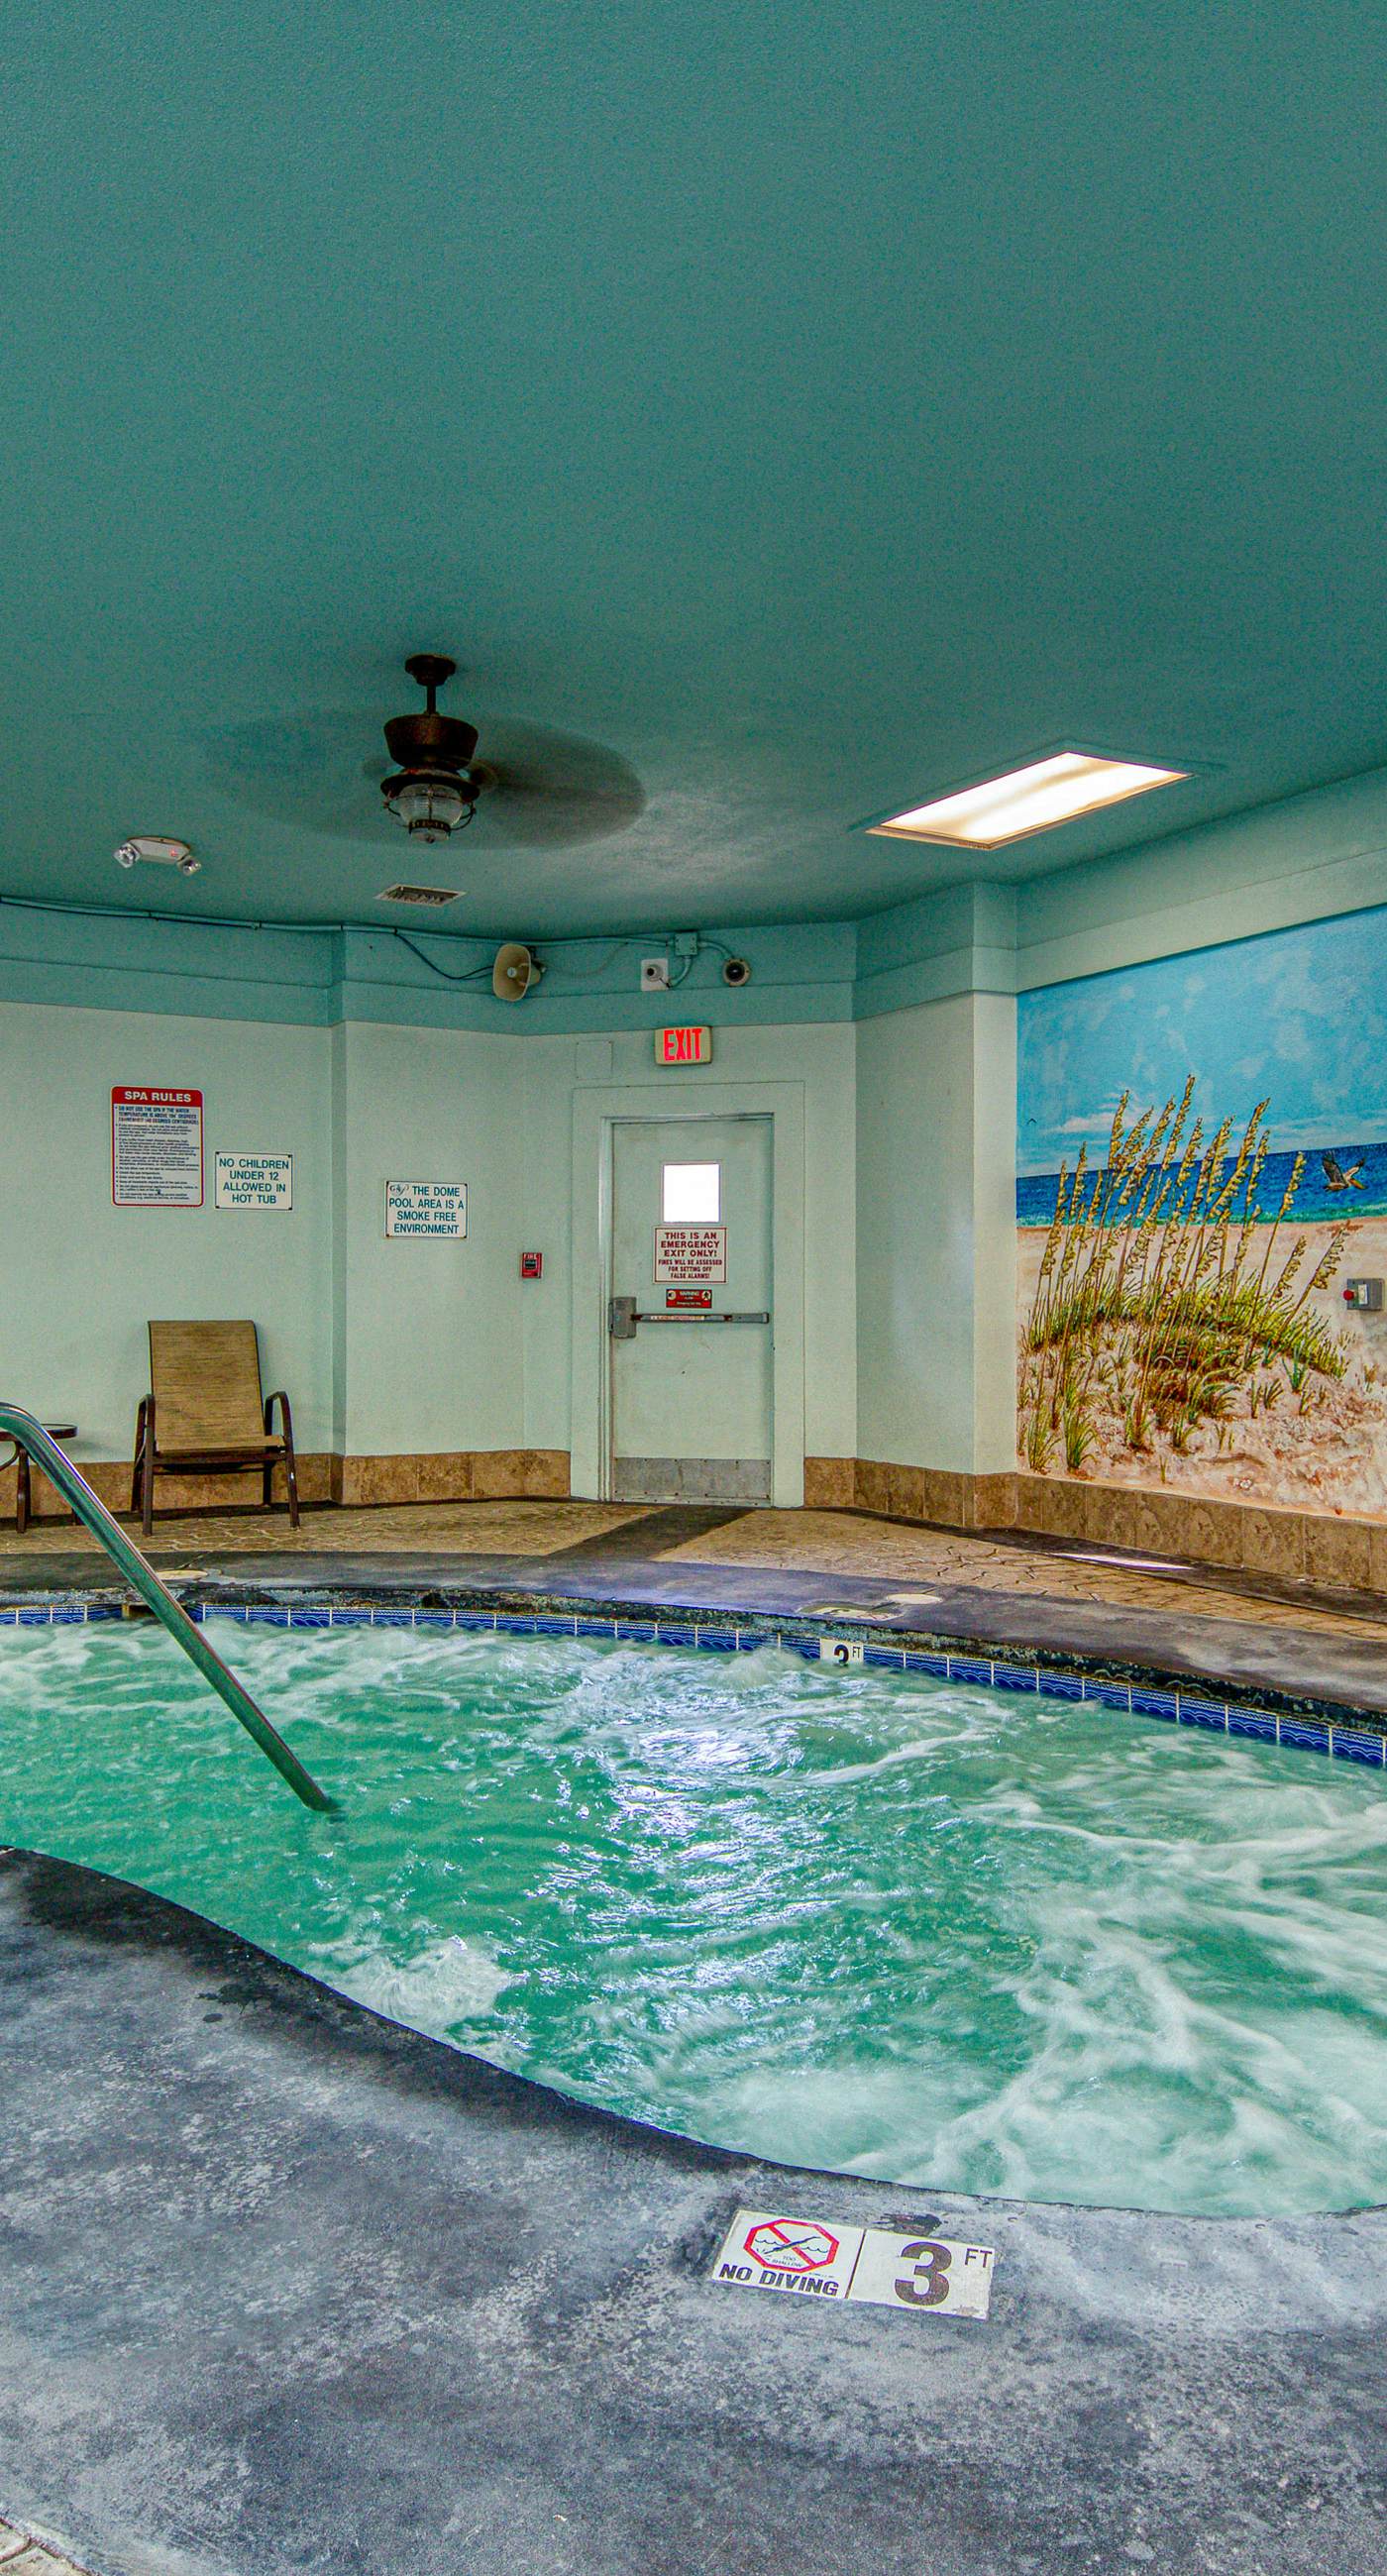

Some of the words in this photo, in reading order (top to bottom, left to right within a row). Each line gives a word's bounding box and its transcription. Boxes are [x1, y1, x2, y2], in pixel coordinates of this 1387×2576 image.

[664, 1028, 703, 1060] EXIT
[124, 1091, 148, 1100] SPA
[151, 1092, 191, 1102] RULES
[219, 1158, 234, 1167] NO
[239, 1159, 289, 1169] CHILDREN
[230, 1171, 264, 1180] UNDER
[269, 1172, 279, 1181] 12
[223, 1182, 272, 1192] ALLOWED
[276, 1184, 286, 1192] IN
[412, 1186, 429, 1195] THE
[434, 1187, 460, 1196] DOME
[232, 1194, 252, 1203] HOT
[257, 1195, 277, 1204] TUB
[389, 1198, 414, 1208] POOL
[418, 1199, 442, 1208] AREA
[446, 1200, 454, 1209] IS
[458, 1200, 464, 1209] A
[397, 1211, 430, 1221] SMOKE
[434, 1212, 456, 1221] FREE
[394, 1223, 459, 1234] ENVIRONMENT
[853, 1646, 861, 1658] FT
[895, 2242, 952, 2306] 3
[964, 2248, 992, 2268] FT
[719, 2263, 753, 2281] NO
[759, 2270, 839, 2297] DIVING
